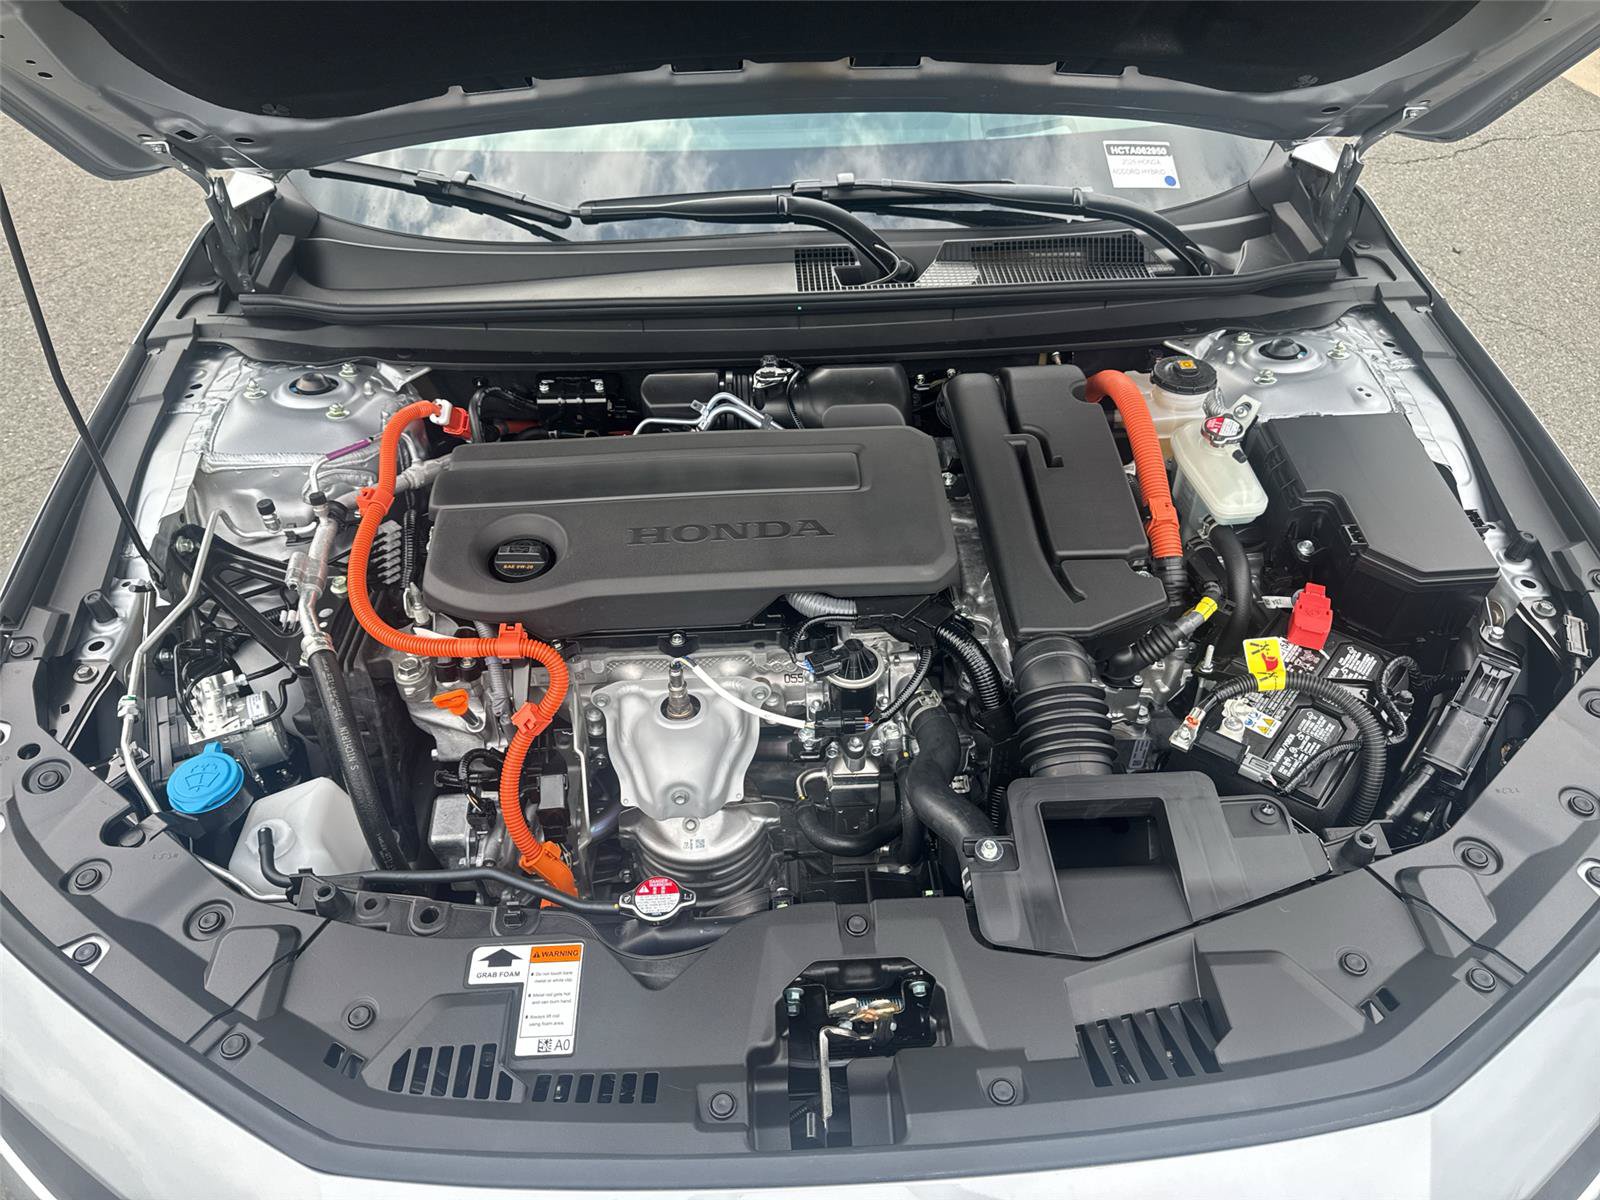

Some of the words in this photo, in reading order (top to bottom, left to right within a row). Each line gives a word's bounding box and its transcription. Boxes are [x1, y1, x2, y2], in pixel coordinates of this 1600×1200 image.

[626, 519, 834, 547] HONDA
[541, 949, 579, 958] WARNING
[476, 971, 498, 979] GRAB
[499, 970, 521, 978] FOAM
